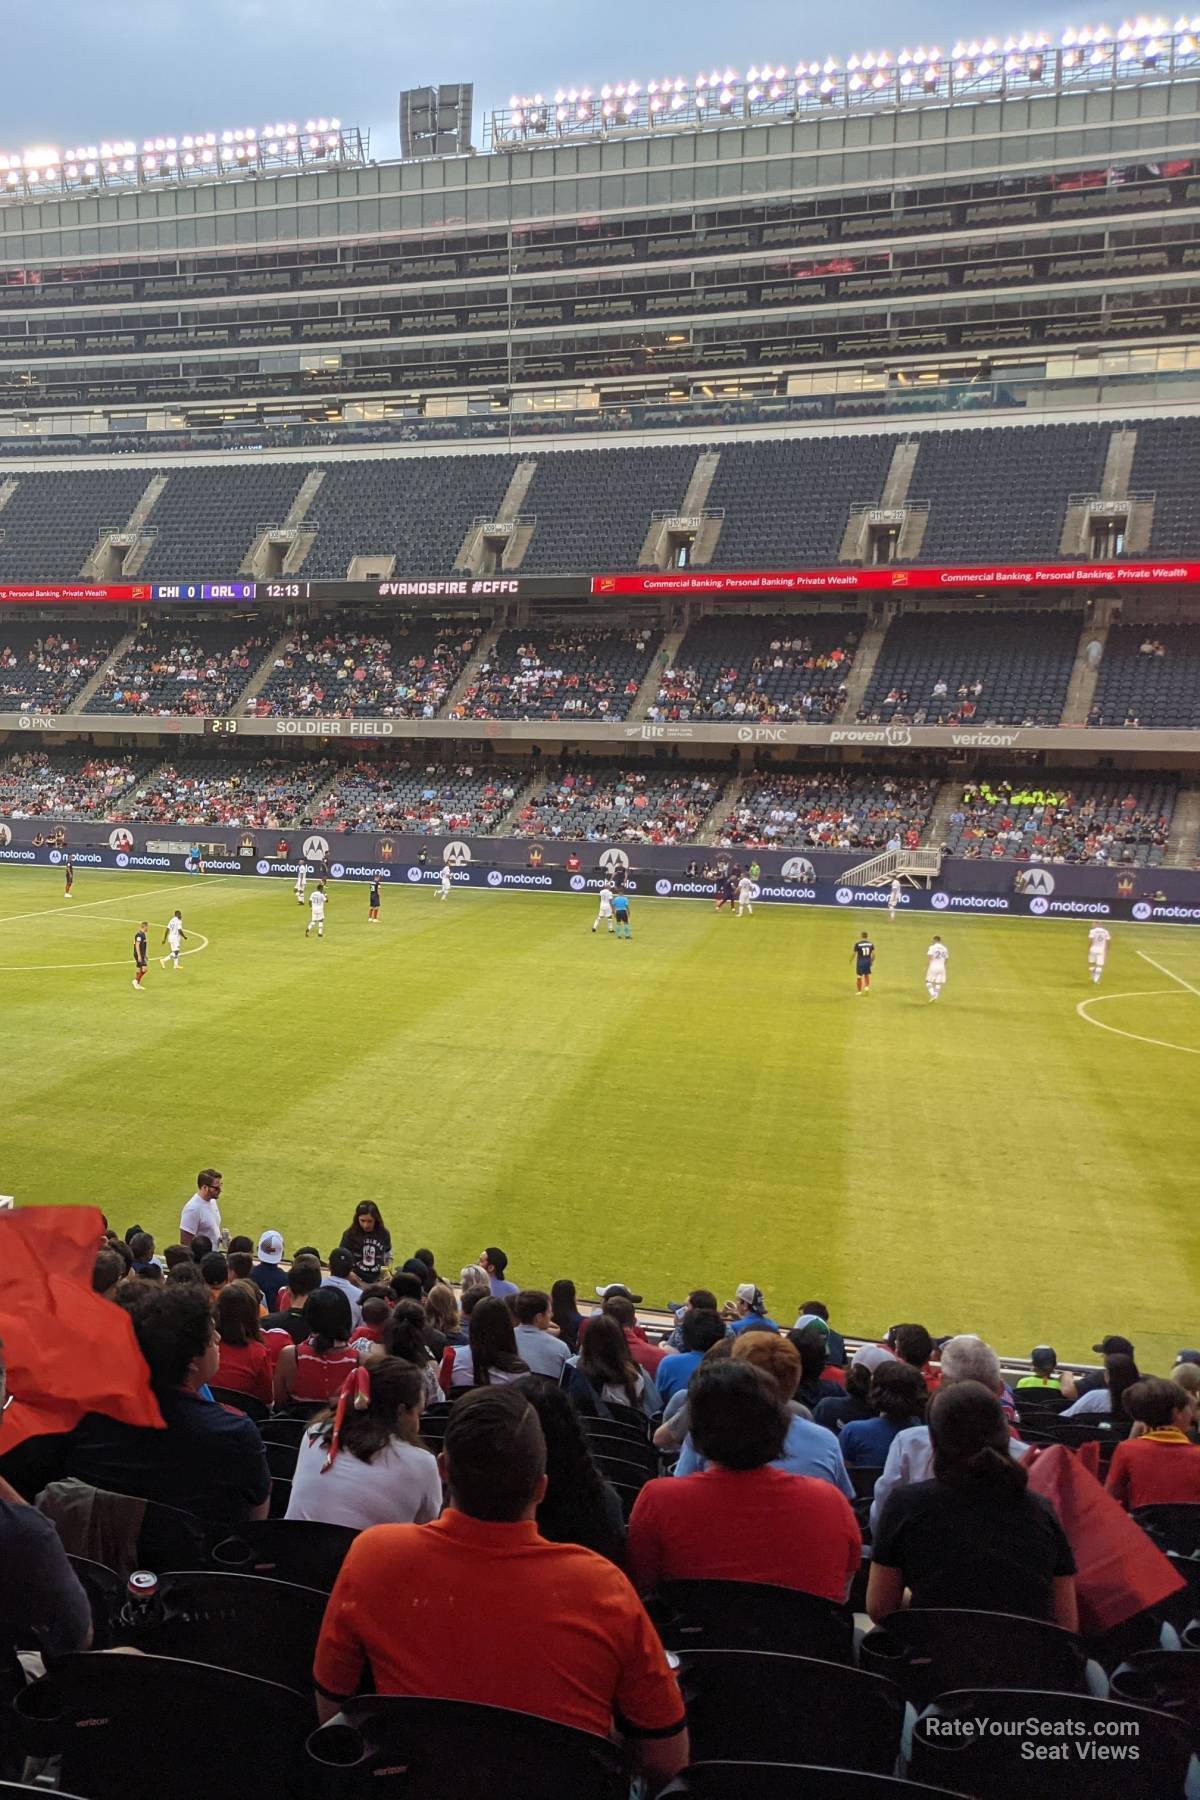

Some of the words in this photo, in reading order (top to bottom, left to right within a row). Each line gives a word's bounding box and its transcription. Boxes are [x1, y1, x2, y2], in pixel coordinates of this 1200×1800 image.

[941, 573, 994, 582] Commercial
[1036, 571, 1074, 580] Personal
[1118, 569, 1151, 578] Private
[1153, 568, 1188, 577] Wealth
[643, 580, 690, 589] Commercial
[726, 578, 760, 586] Personal
[797, 576, 825, 585] Private
[828, 575, 858, 584] Wealth
[9, 590, 34, 598] Personal
[85, 589, 108, 597] Wealth
[158, 586, 179, 598] CHI
[187, 586, 195, 598] 0
[211, 586, 235, 598] ORL
[243, 585, 251, 597] 0
[266, 585, 299, 597] 12:13
[379, 582, 467, 595] #VAMOSFIRE
[472, 581, 519, 593] #CFFC
[32, 719, 56, 728] PNC
[213, 720, 238, 732] 2:13
[277, 722, 341, 734] SOLDIER
[351, 722, 393, 735] FIELD
[756, 729, 787, 741] PNC
[830, 731, 886, 743] proven
[952, 732, 1013, 746] verizon
[129, 856, 170, 866] motorola
[199, 859, 241, 869] motorola
[270, 862, 315, 873] motorla
[345, 866, 391, 876] motorola
[423, 870, 470, 880] motrola
[503, 874, 552, 885] motorola
[586, 878, 637, 889] motola
[672, 883, 717, 893] motorol
[762, 887, 816, 898] motorola
[854, 892, 910, 903] motorla
[951, 896, 1009, 908] motorola
[1050, 901, 1110, 914] motorola
[1152, 906, 1200, 918] motoro
[861, 947, 870, 956] 11
